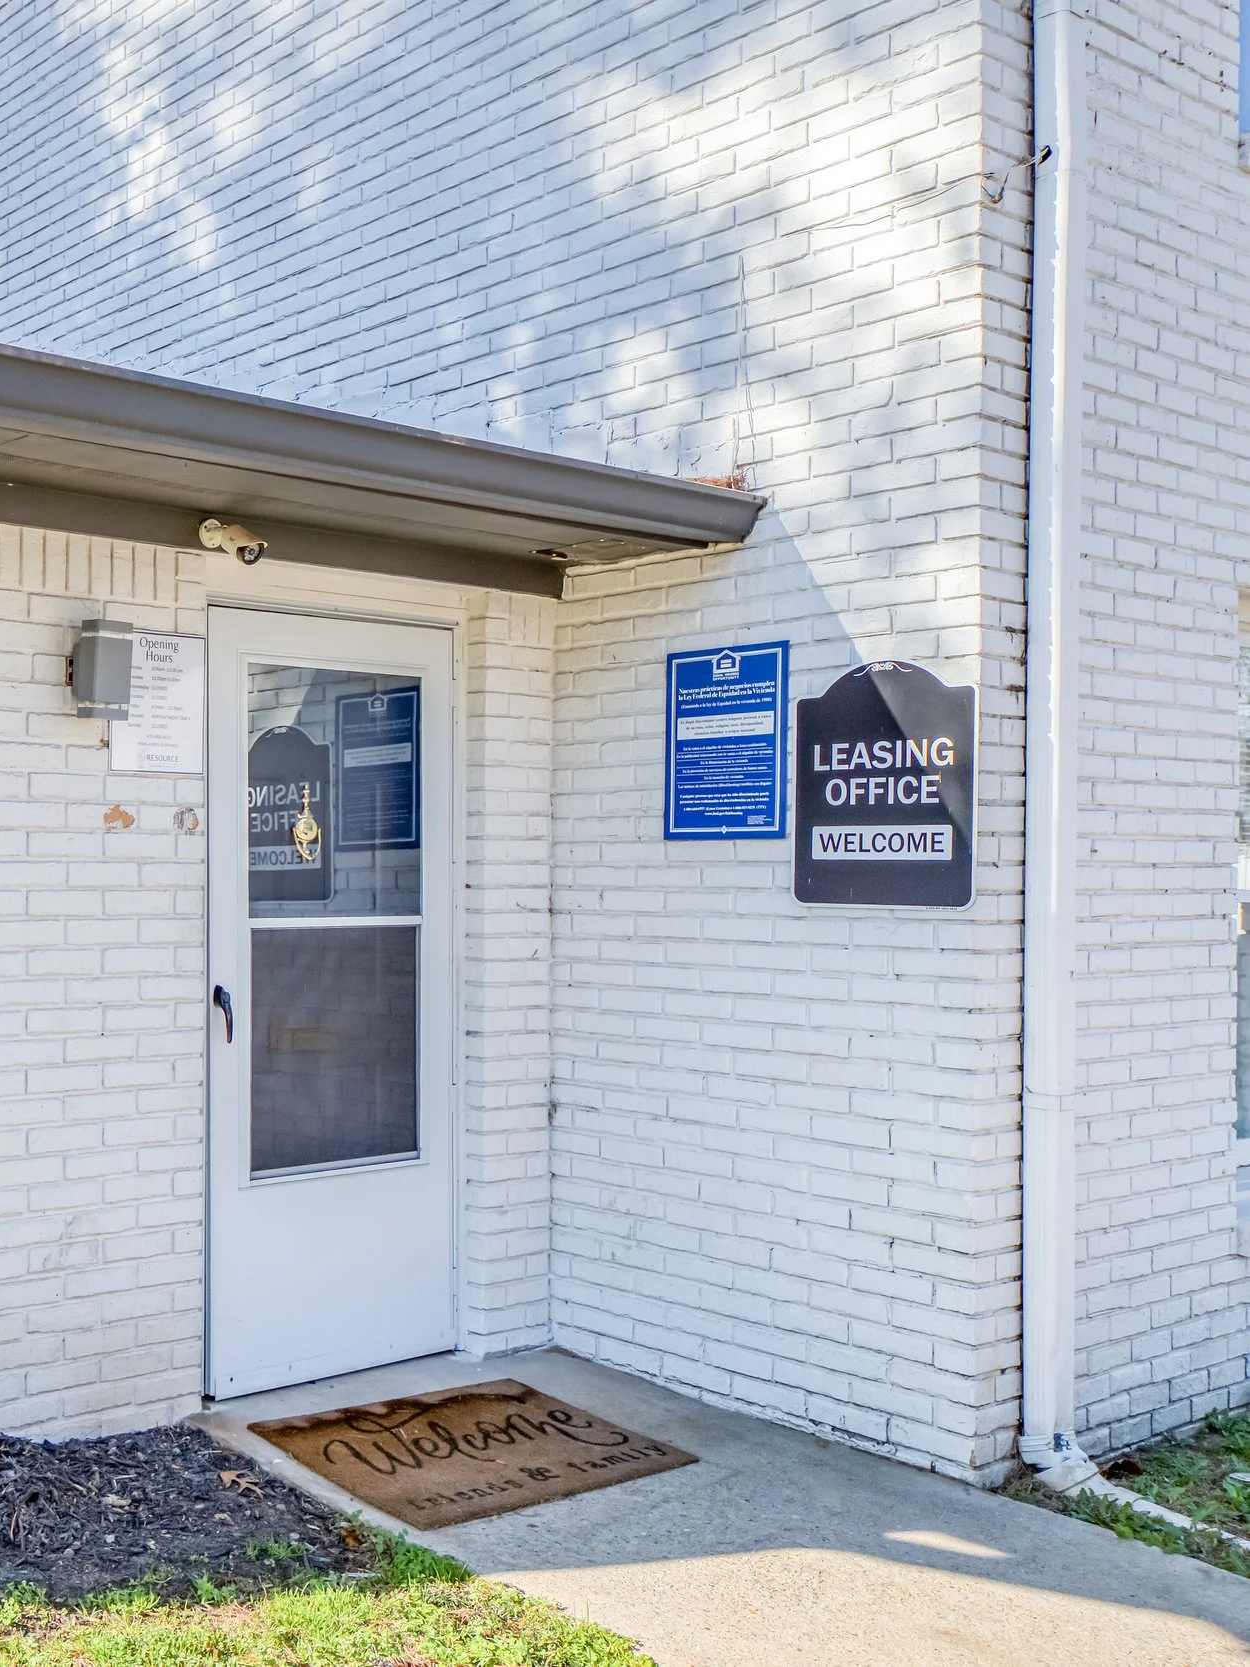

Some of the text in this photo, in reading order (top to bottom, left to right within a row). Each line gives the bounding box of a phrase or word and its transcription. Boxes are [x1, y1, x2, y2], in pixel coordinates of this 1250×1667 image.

[139, 636, 179, 653] Opening
[146, 650, 173, 663] Hours
[146, 754, 179, 763] RESOURCE
[814, 737, 954, 772] LEASING
[825, 775, 940, 806] OFFICE
[819, 832, 945, 853] WELCOME
[323, 1401, 628, 1476] Welcome
[519, 1466, 559, 1481] &
[569, 1444, 668, 1476] family
